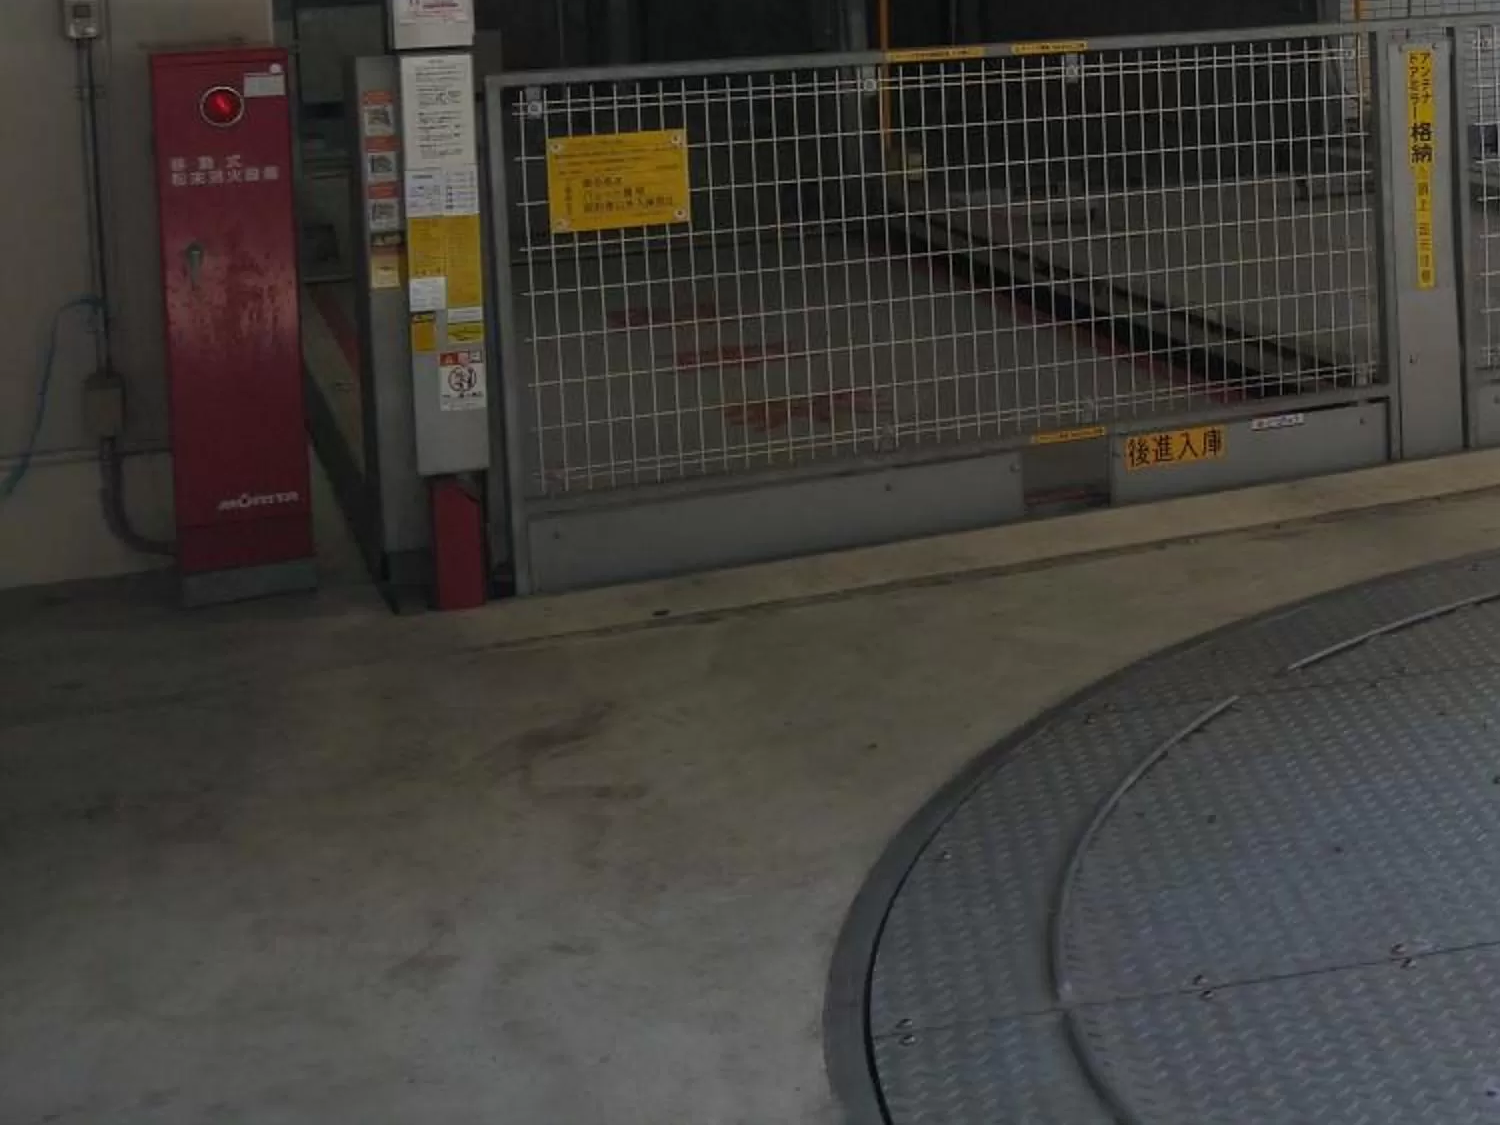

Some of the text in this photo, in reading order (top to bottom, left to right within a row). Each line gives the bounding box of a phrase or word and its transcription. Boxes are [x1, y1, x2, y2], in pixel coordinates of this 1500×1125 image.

[1420, 52, 1433, 105] アンテナ
[1410, 122, 1433, 164] 格納
[1126, 427, 1223, 468] 後進入庫
